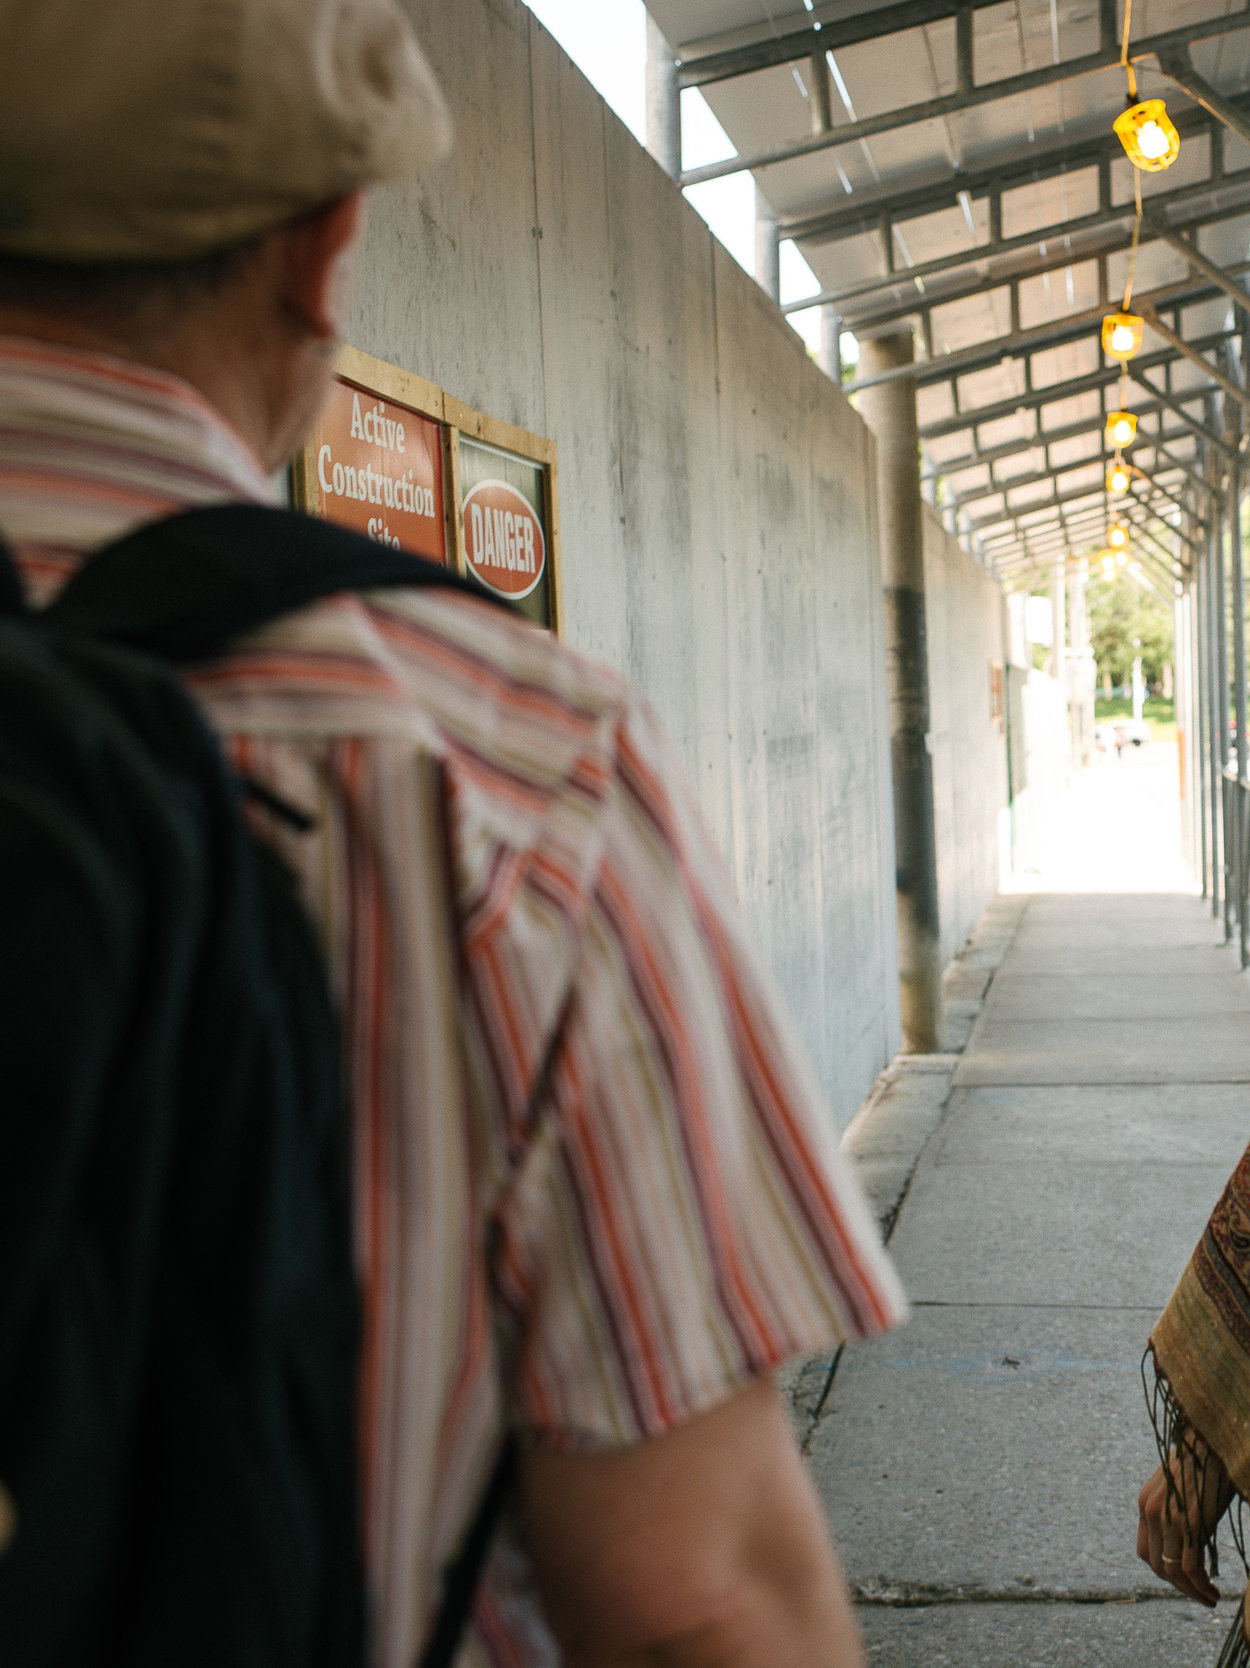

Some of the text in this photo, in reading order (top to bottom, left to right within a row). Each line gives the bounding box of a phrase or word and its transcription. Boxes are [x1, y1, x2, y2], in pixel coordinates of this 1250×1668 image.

[350, 393, 405, 453] Active
[318, 445, 435, 517] Construction
[471, 503, 536, 573] DANGER
